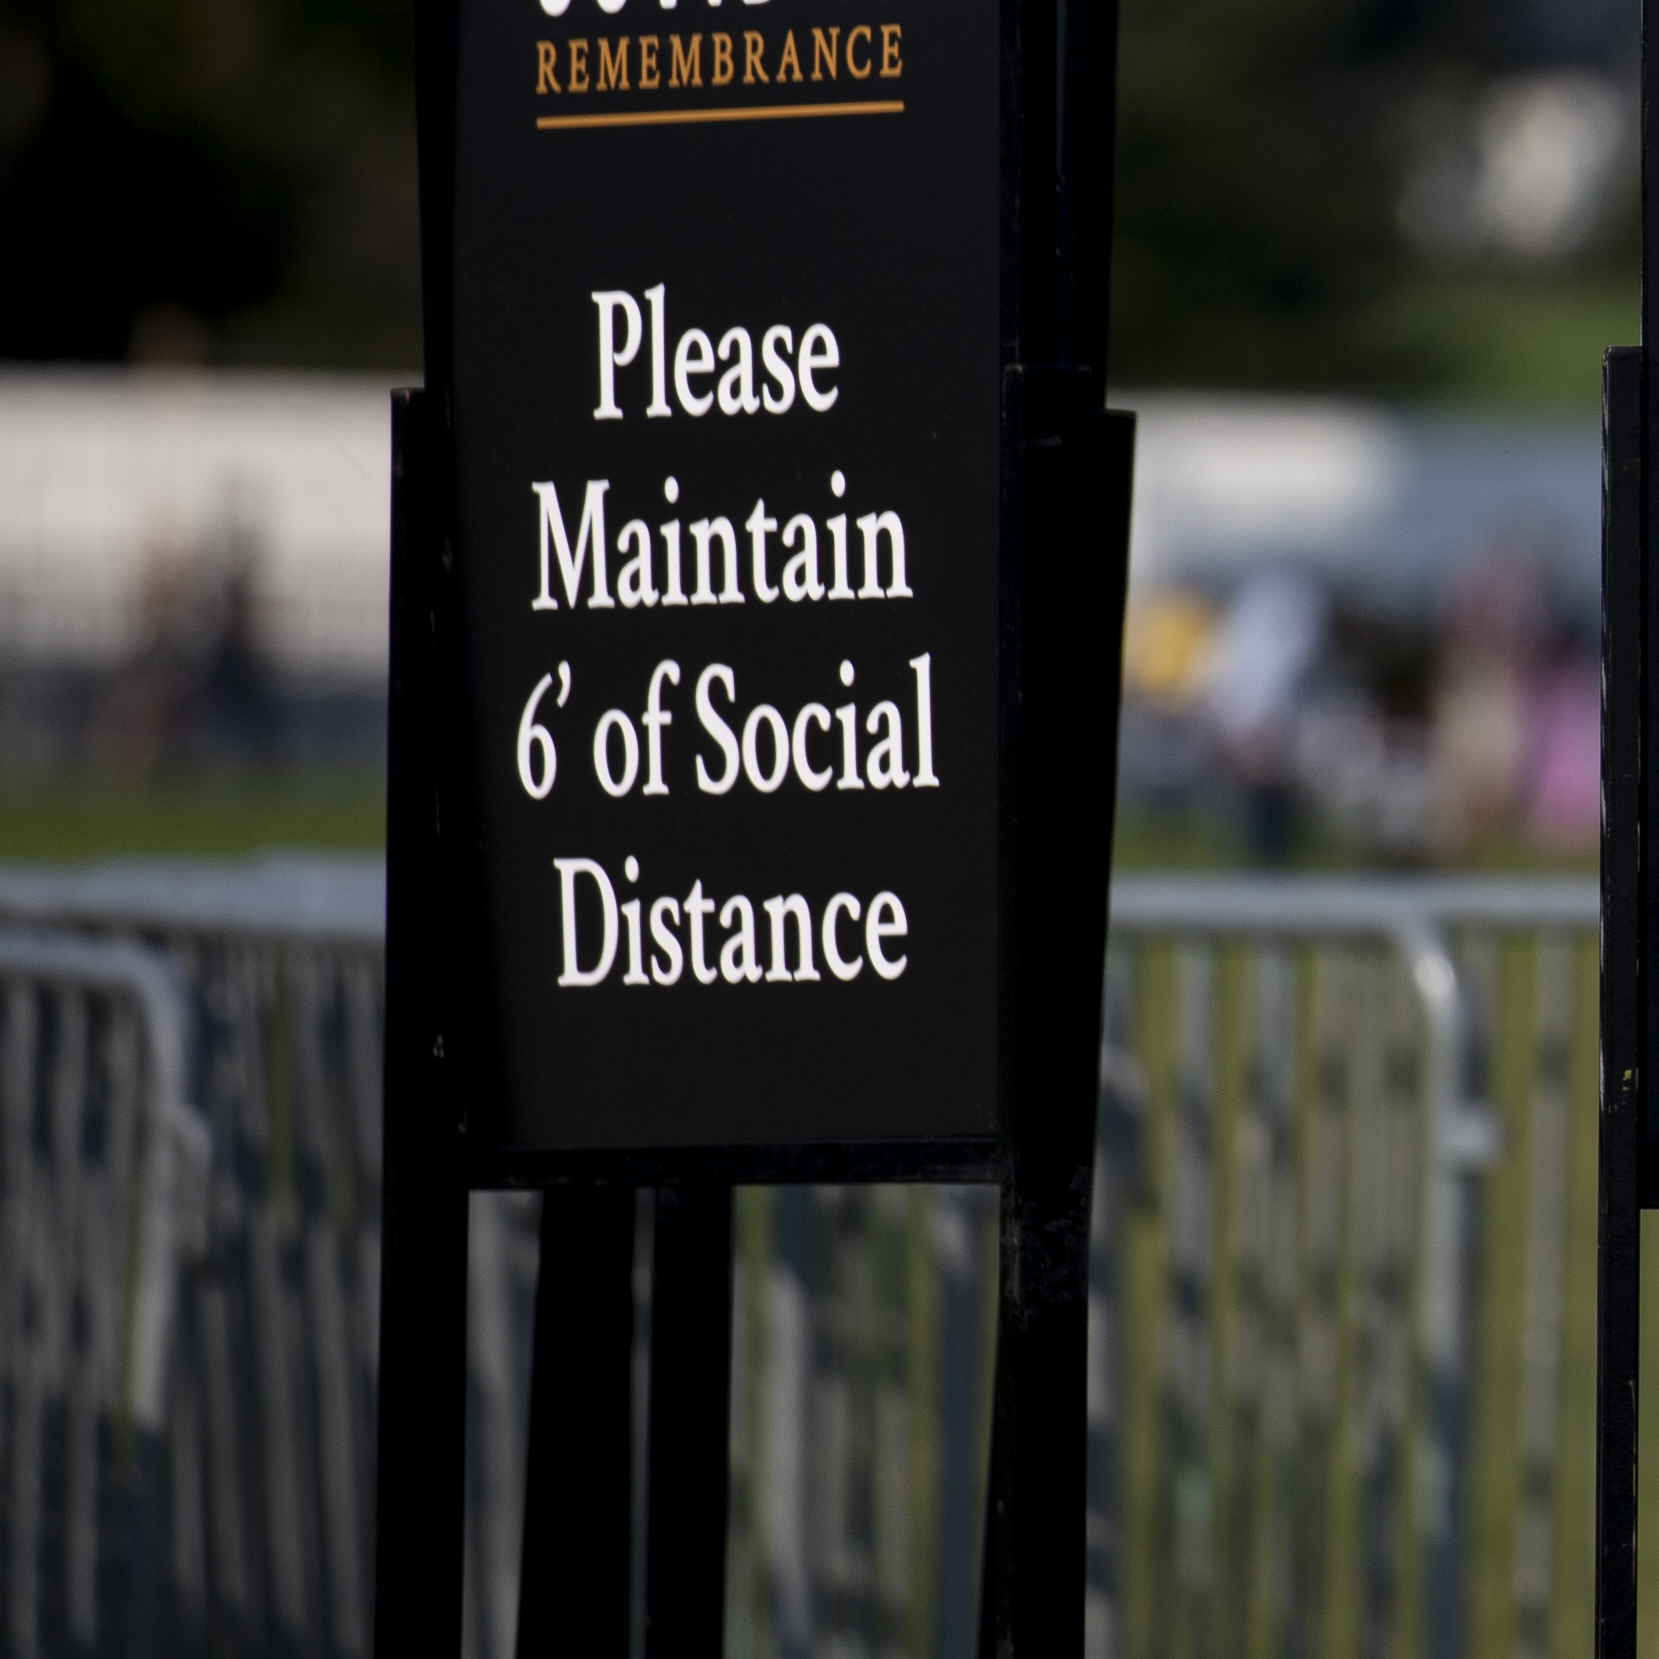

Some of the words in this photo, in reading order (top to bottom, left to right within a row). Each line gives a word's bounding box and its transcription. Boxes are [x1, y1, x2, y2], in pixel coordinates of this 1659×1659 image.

[536, 24, 903, 94] REMEMBRANCE
[590, 282, 841, 421] Please
[531, 469, 914, 611] Maintain
[592, 658, 681, 798] of
[694, 651, 940, 796] Social
[552, 854, 909, 987] Distance
